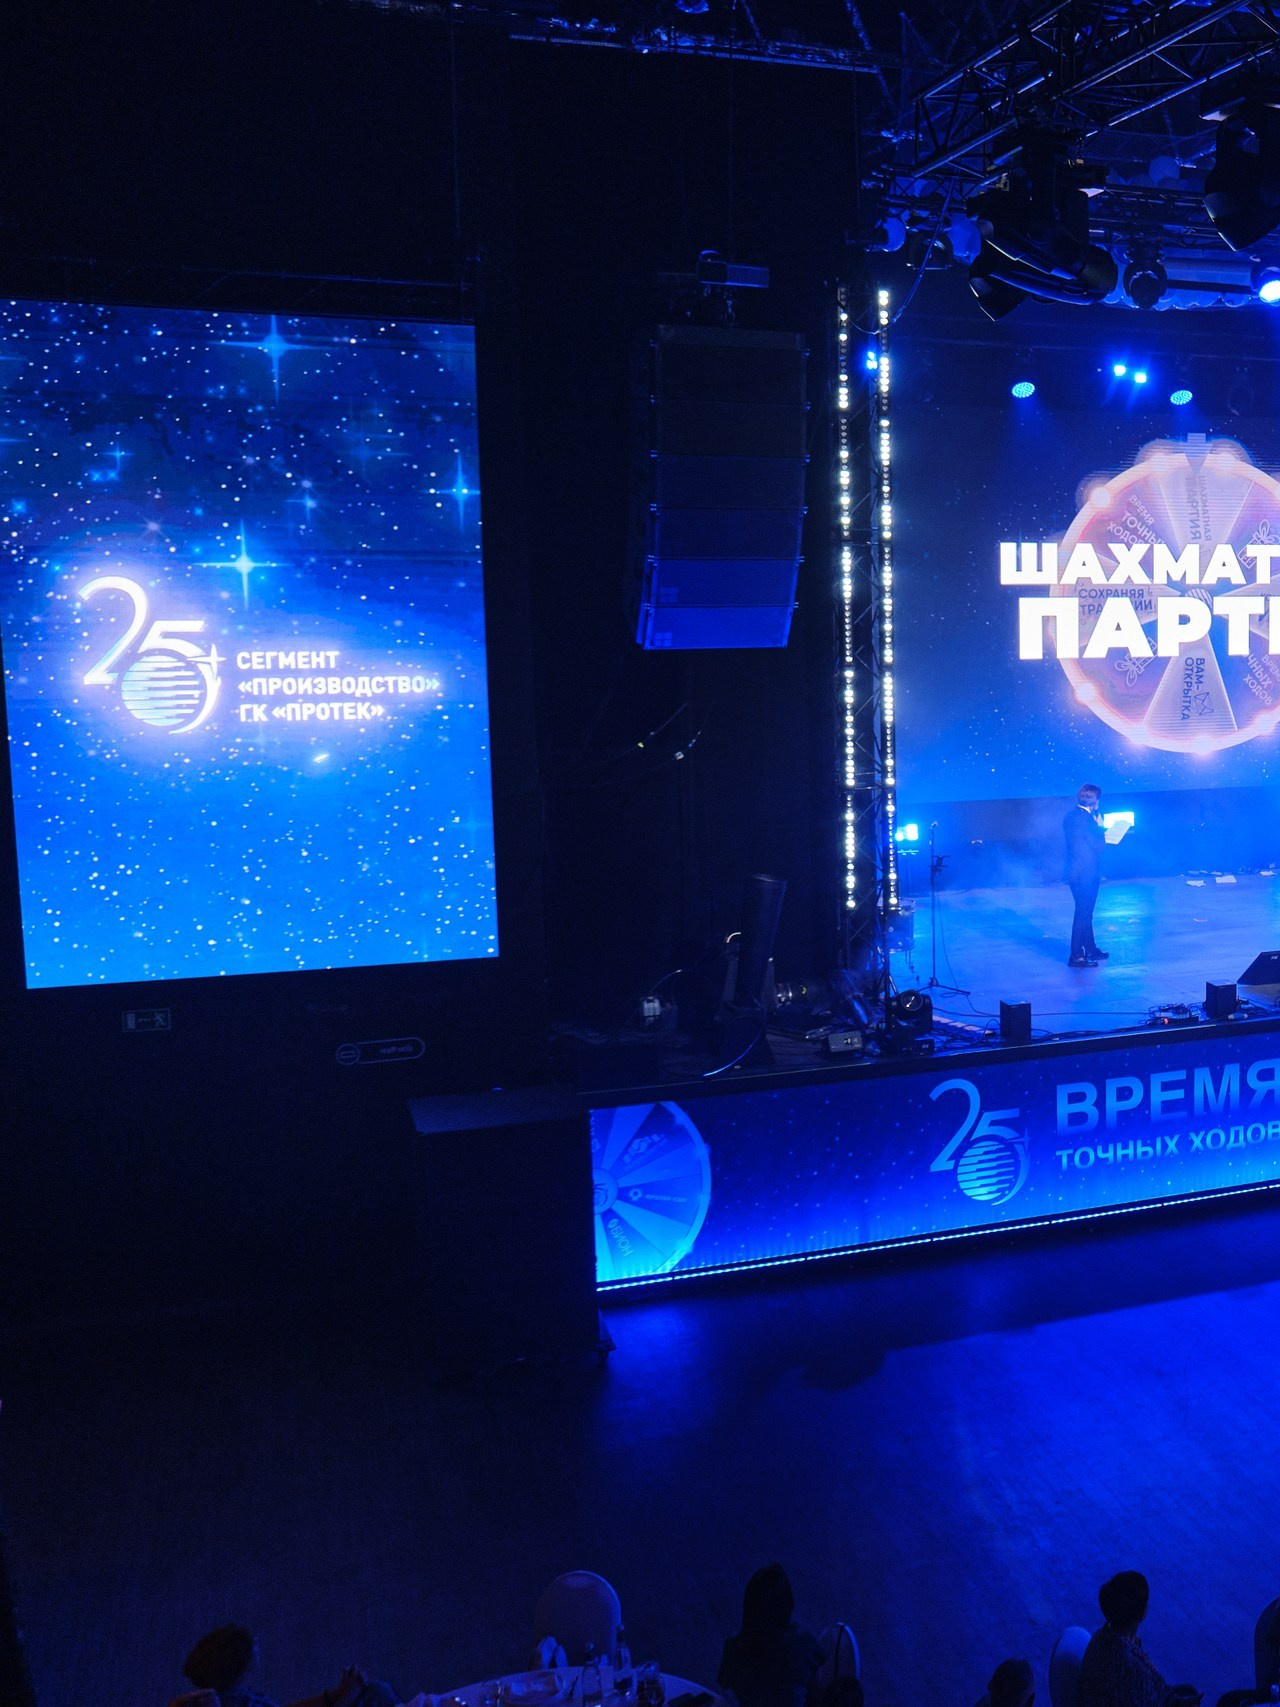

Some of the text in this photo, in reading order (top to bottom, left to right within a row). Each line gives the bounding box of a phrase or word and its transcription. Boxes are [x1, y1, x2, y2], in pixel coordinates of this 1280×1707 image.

[1129, 494, 1155, 525] ВРЕМЯ
[1121, 511, 1165, 544] ТОЧНЫ
[1078, 588, 1145, 599] СОХРАНЯЯ
[1079, 599, 1153, 615] ТРАИИ
[78, 576, 222, 735] 25
[236, 651, 340, 670] СЕГМЕНТ
[1247, 653, 1272, 688] ЧНЫХ
[237, 675, 440, 697] «ПРОИЗВОДСТВО»
[1181, 656, 1195, 720] ОТКРЫТКА
[1242, 674, 1273, 705] ХОДОВ
[240, 702, 385, 722] ГК «ПРОТЕК»
[928, 1078, 1031, 1207] 25
[1055, 1135, 1179, 1173] ТОЧНЫХ
